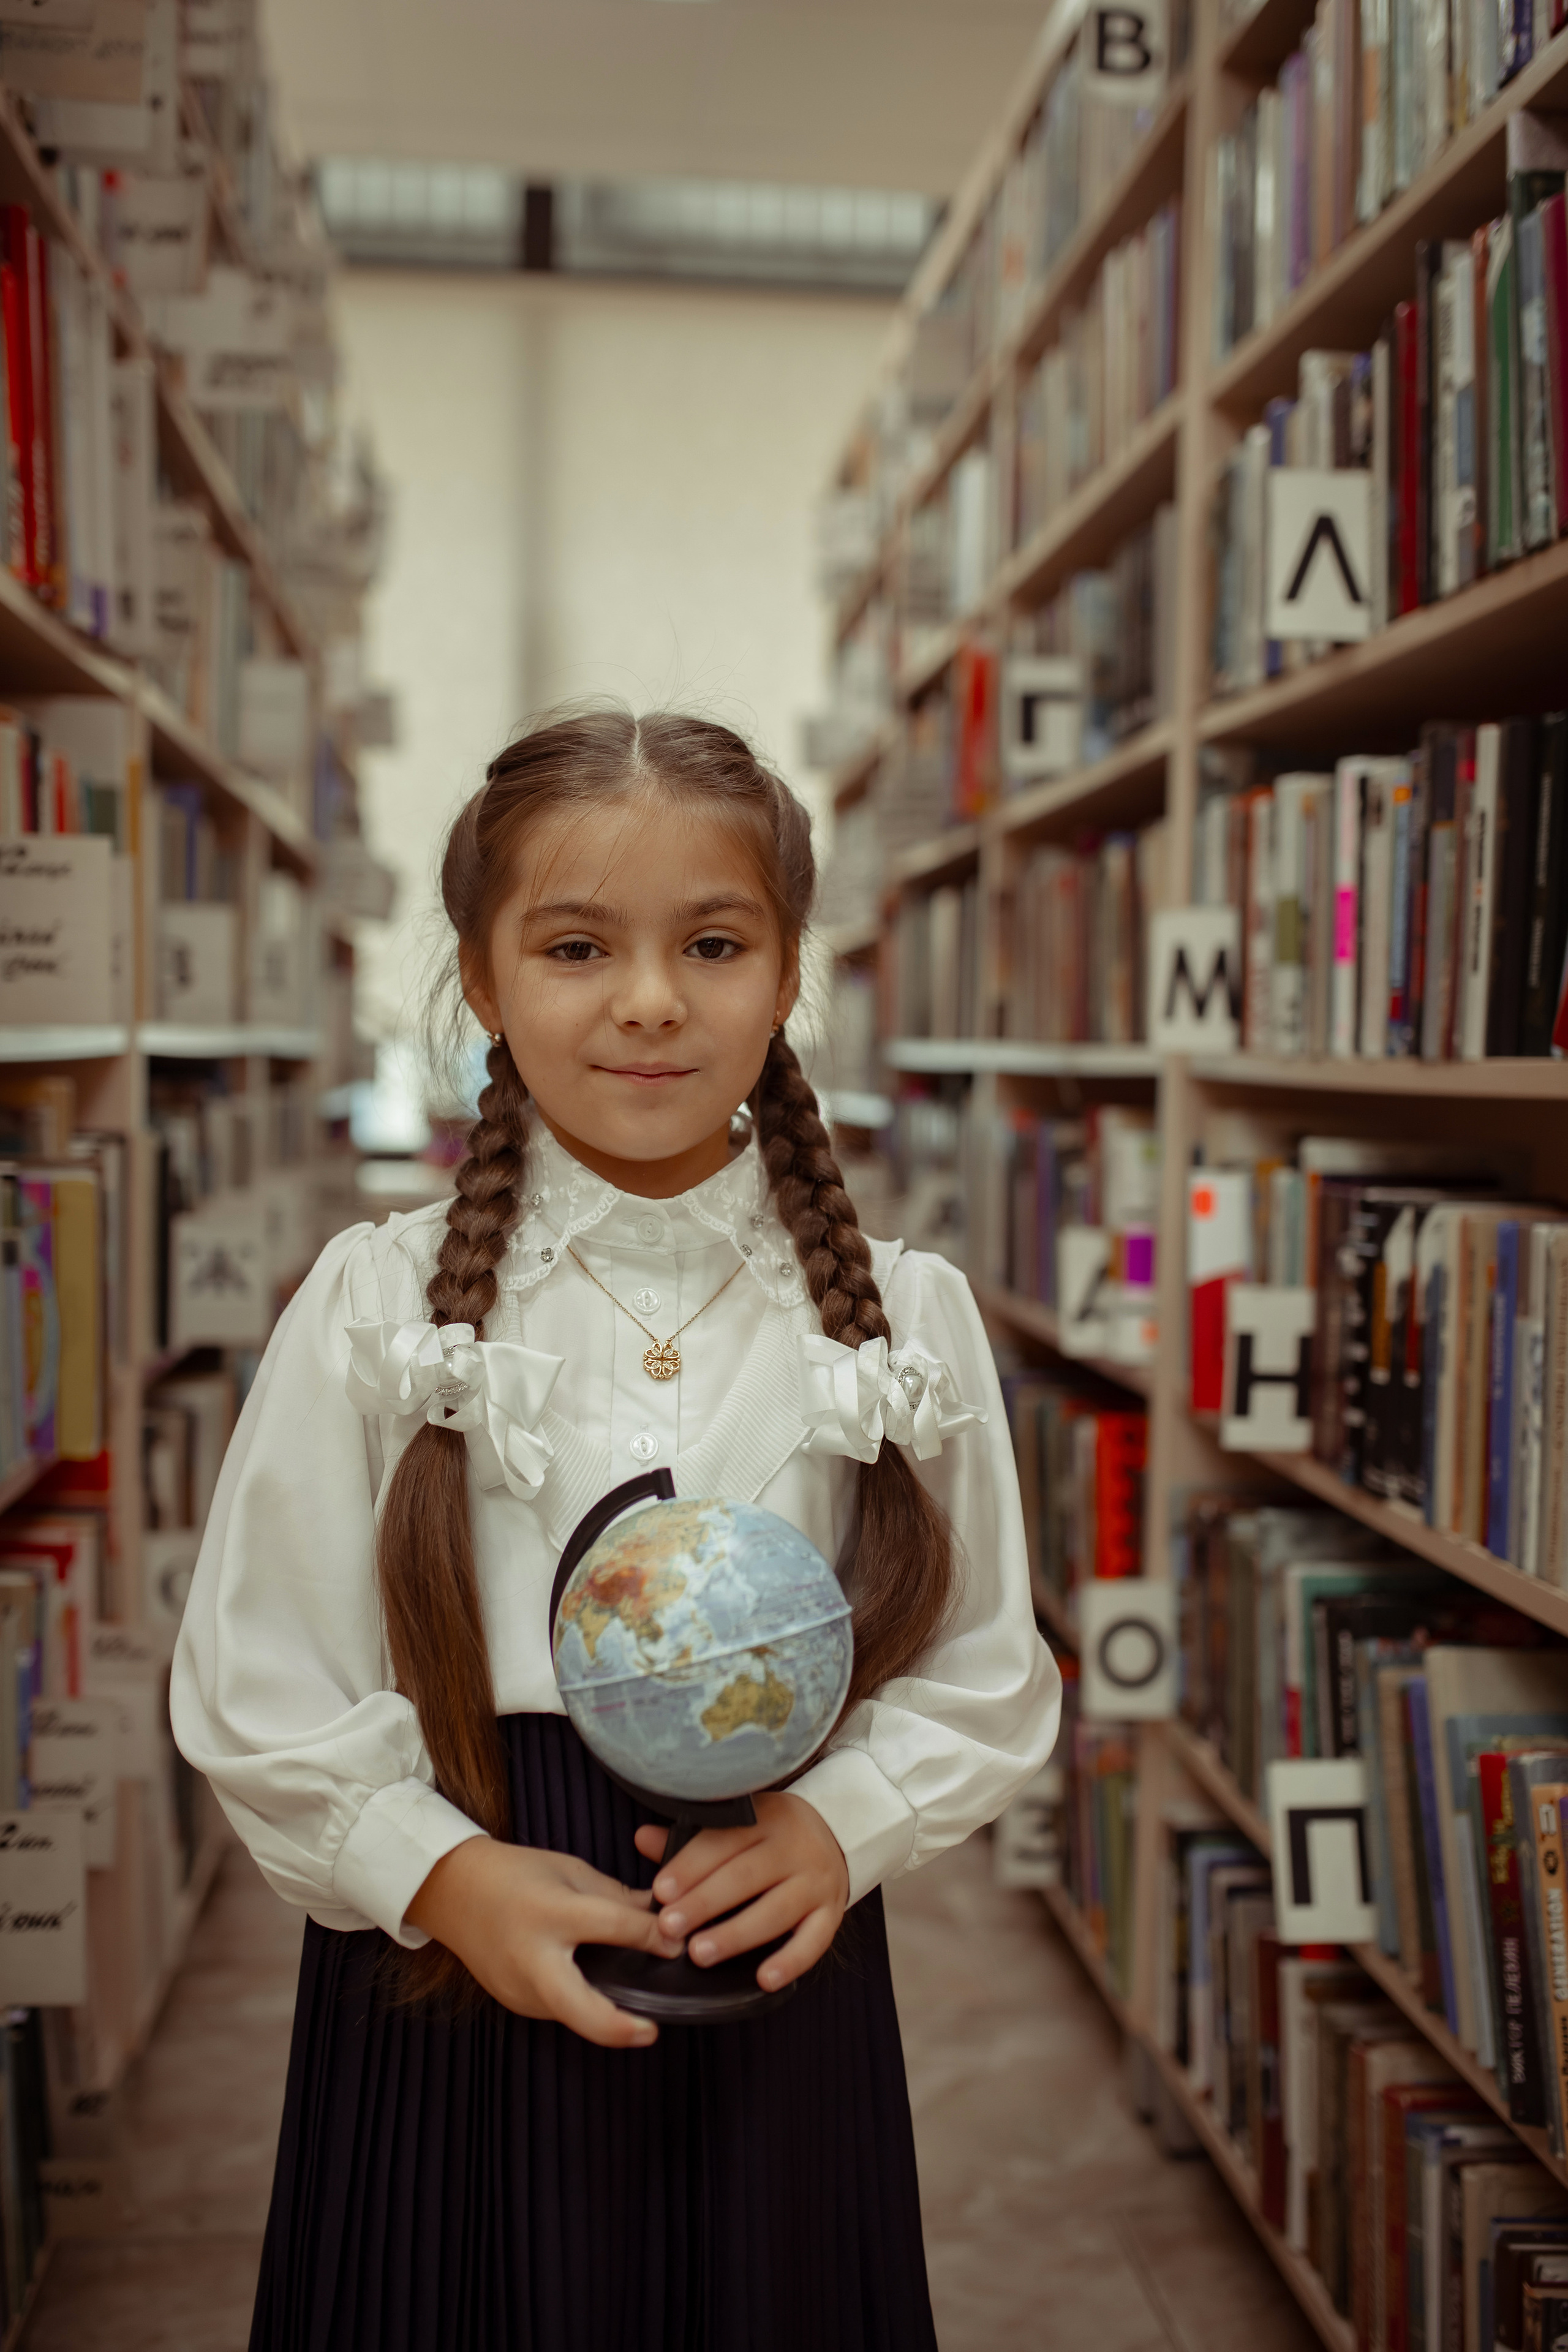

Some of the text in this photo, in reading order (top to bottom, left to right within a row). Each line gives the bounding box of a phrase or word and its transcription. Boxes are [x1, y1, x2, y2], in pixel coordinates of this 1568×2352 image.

[1097, 9, 1152, 74] В
[1286, 514, 1362, 603] Л
[1166, 948, 1242, 1022] М
[1234, 1333, 1311, 1417] Н
[1099, 1618, 1164, 1687] О
[1287, 1806, 1372, 1904] П
[1502, 1937, 1523, 2015] ПЕЛЕВИН
